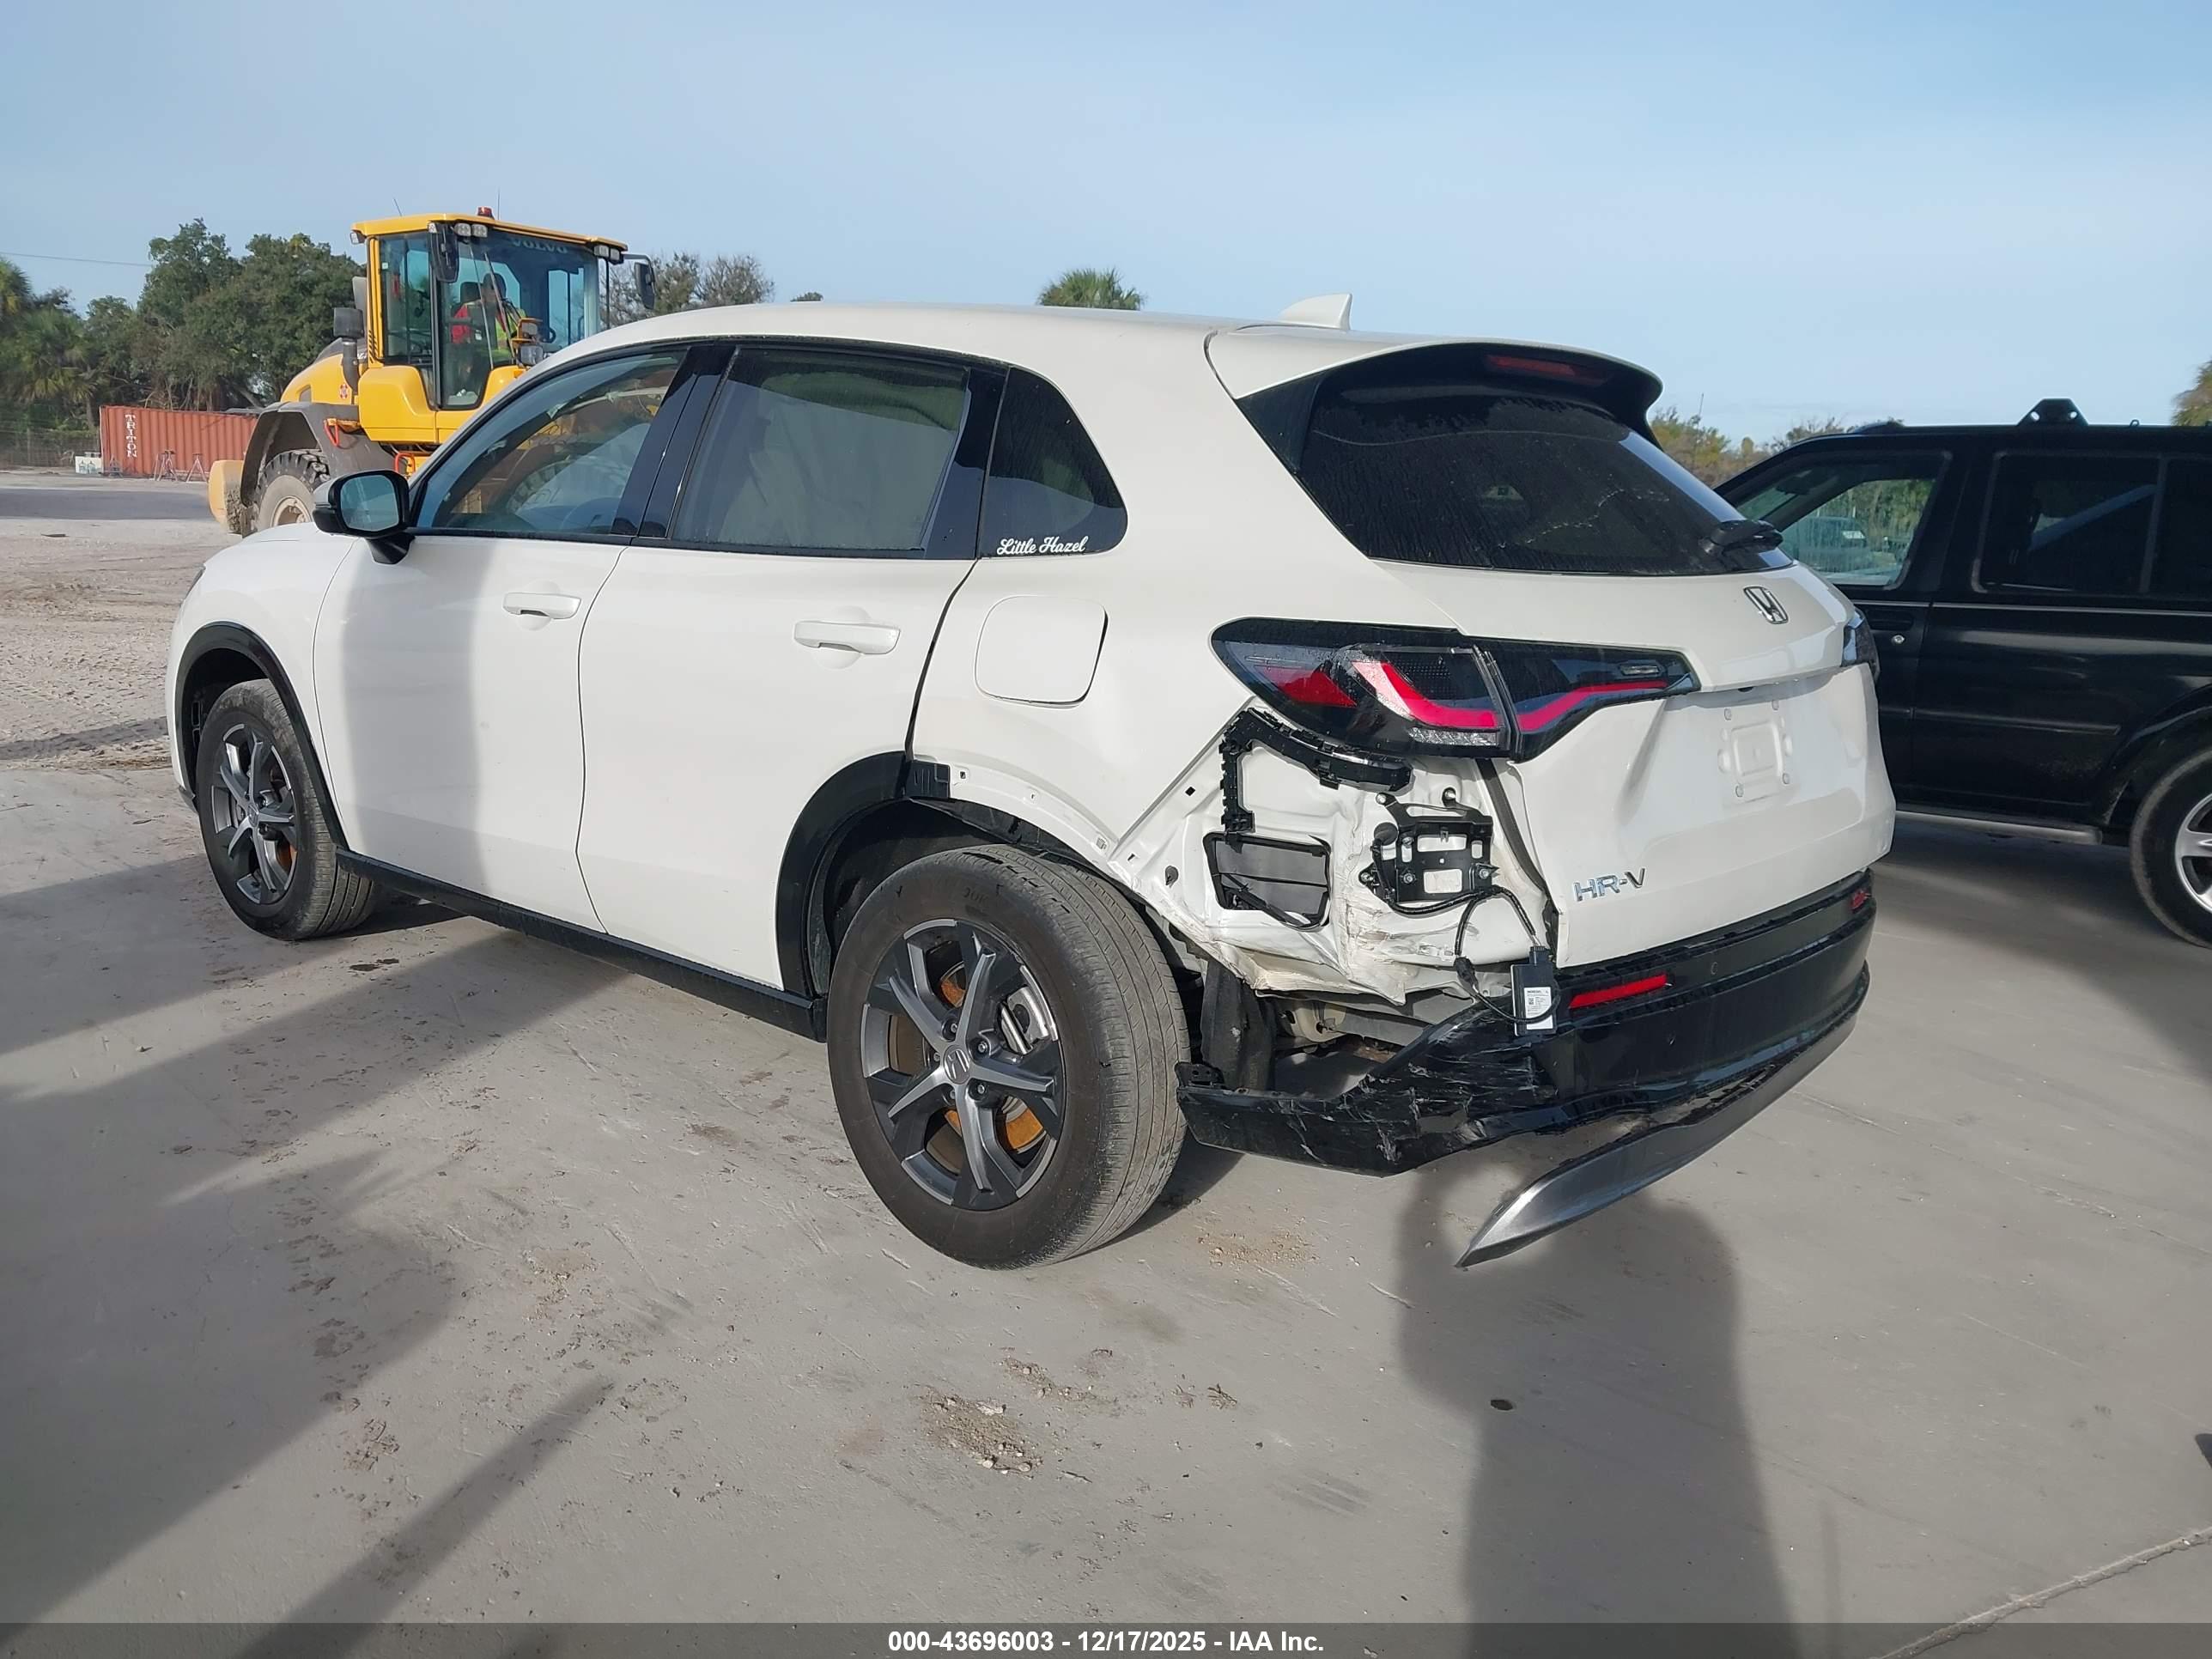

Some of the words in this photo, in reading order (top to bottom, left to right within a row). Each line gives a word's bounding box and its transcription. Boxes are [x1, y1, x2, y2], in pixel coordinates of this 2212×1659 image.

[512, 239, 568, 254] VOLVO
[125, 414, 137, 458] TRITON
[997, 538, 1037, 556] Little
[1039, 535, 1089, 554] Hazel
[1573, 867, 1647, 902] HR-V
